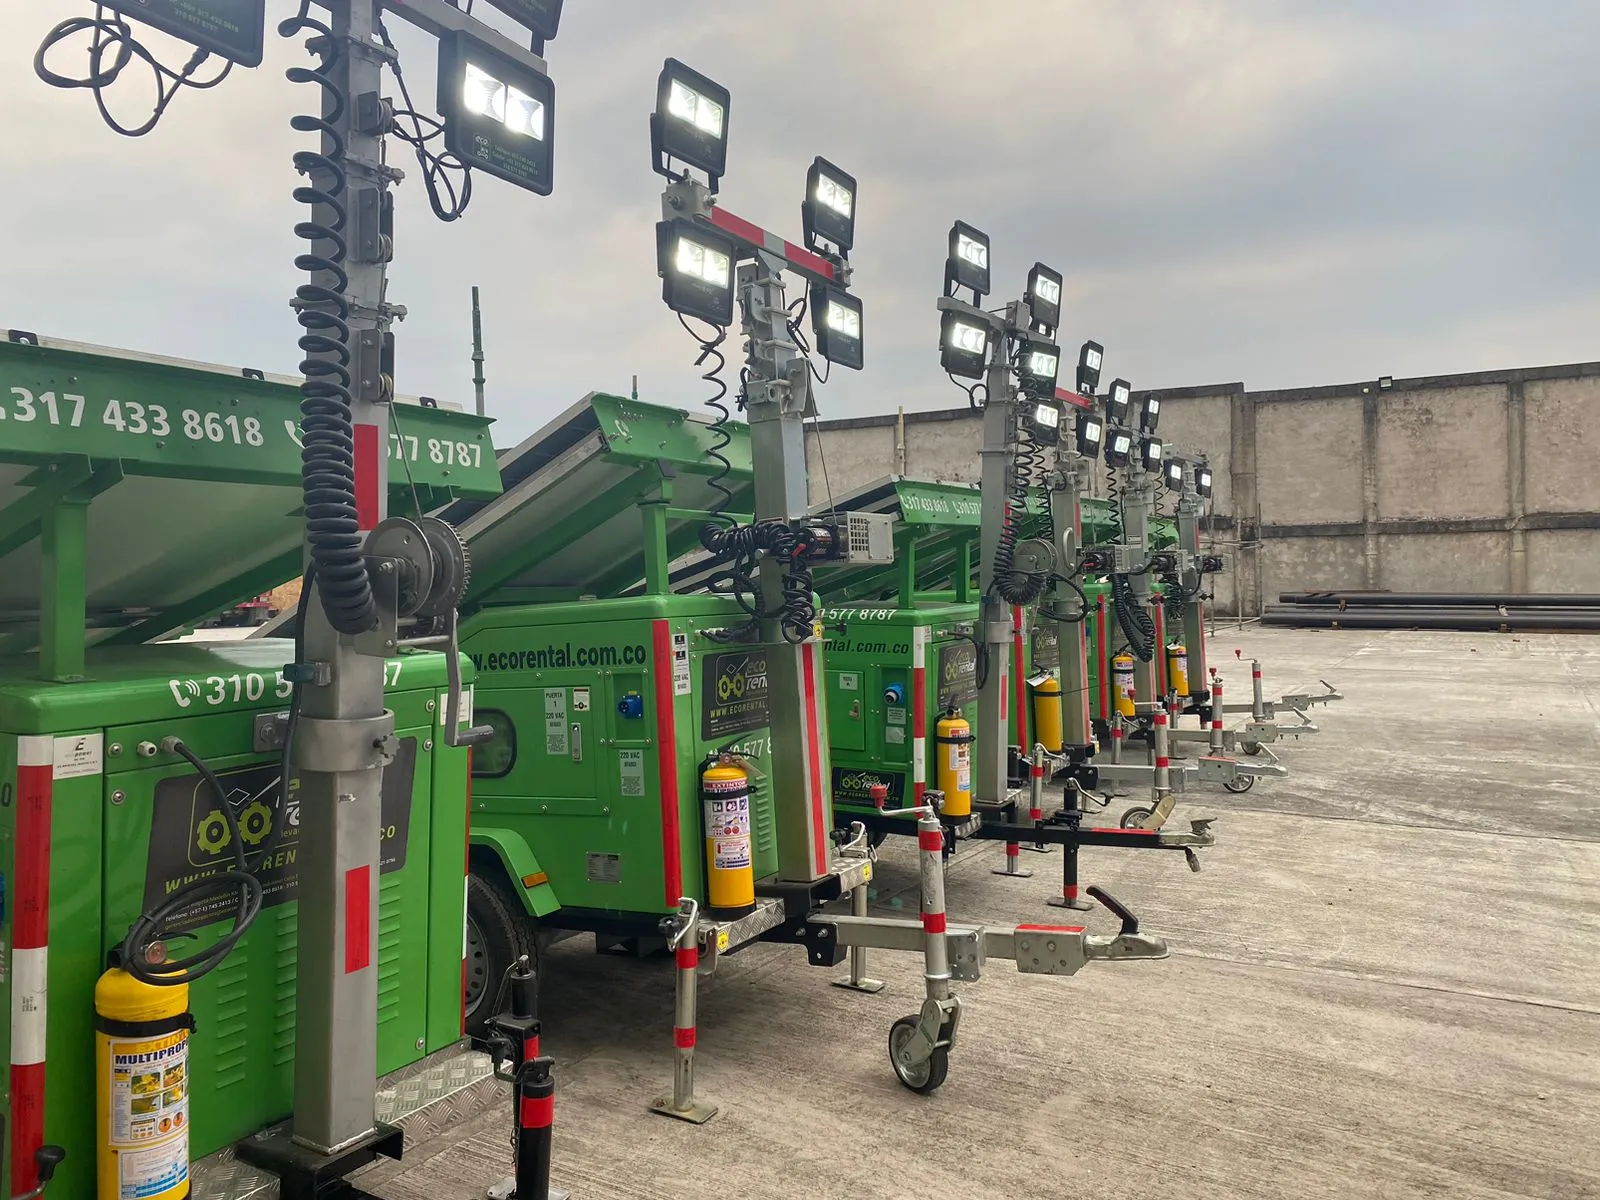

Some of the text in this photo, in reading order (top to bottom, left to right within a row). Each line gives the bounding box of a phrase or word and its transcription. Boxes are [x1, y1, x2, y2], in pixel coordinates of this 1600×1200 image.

[10, 386, 86, 427] 317
[102, 399, 171, 437] 433
[181, 408, 264, 447] 8618
[427, 438, 481, 468] 8787
[828, 608, 897, 621] 577 8787
[824, 639, 910, 655] ntal.com.co
[470, 642, 647, 672] w.ecorental.com.co
[746, 659, 767, 674] eco
[206, 673, 265, 706] 310
[545, 712, 555, 720] 220
[709, 700, 769, 719] WWW.ECORENTAL.
[620, 751, 630, 760] 220
